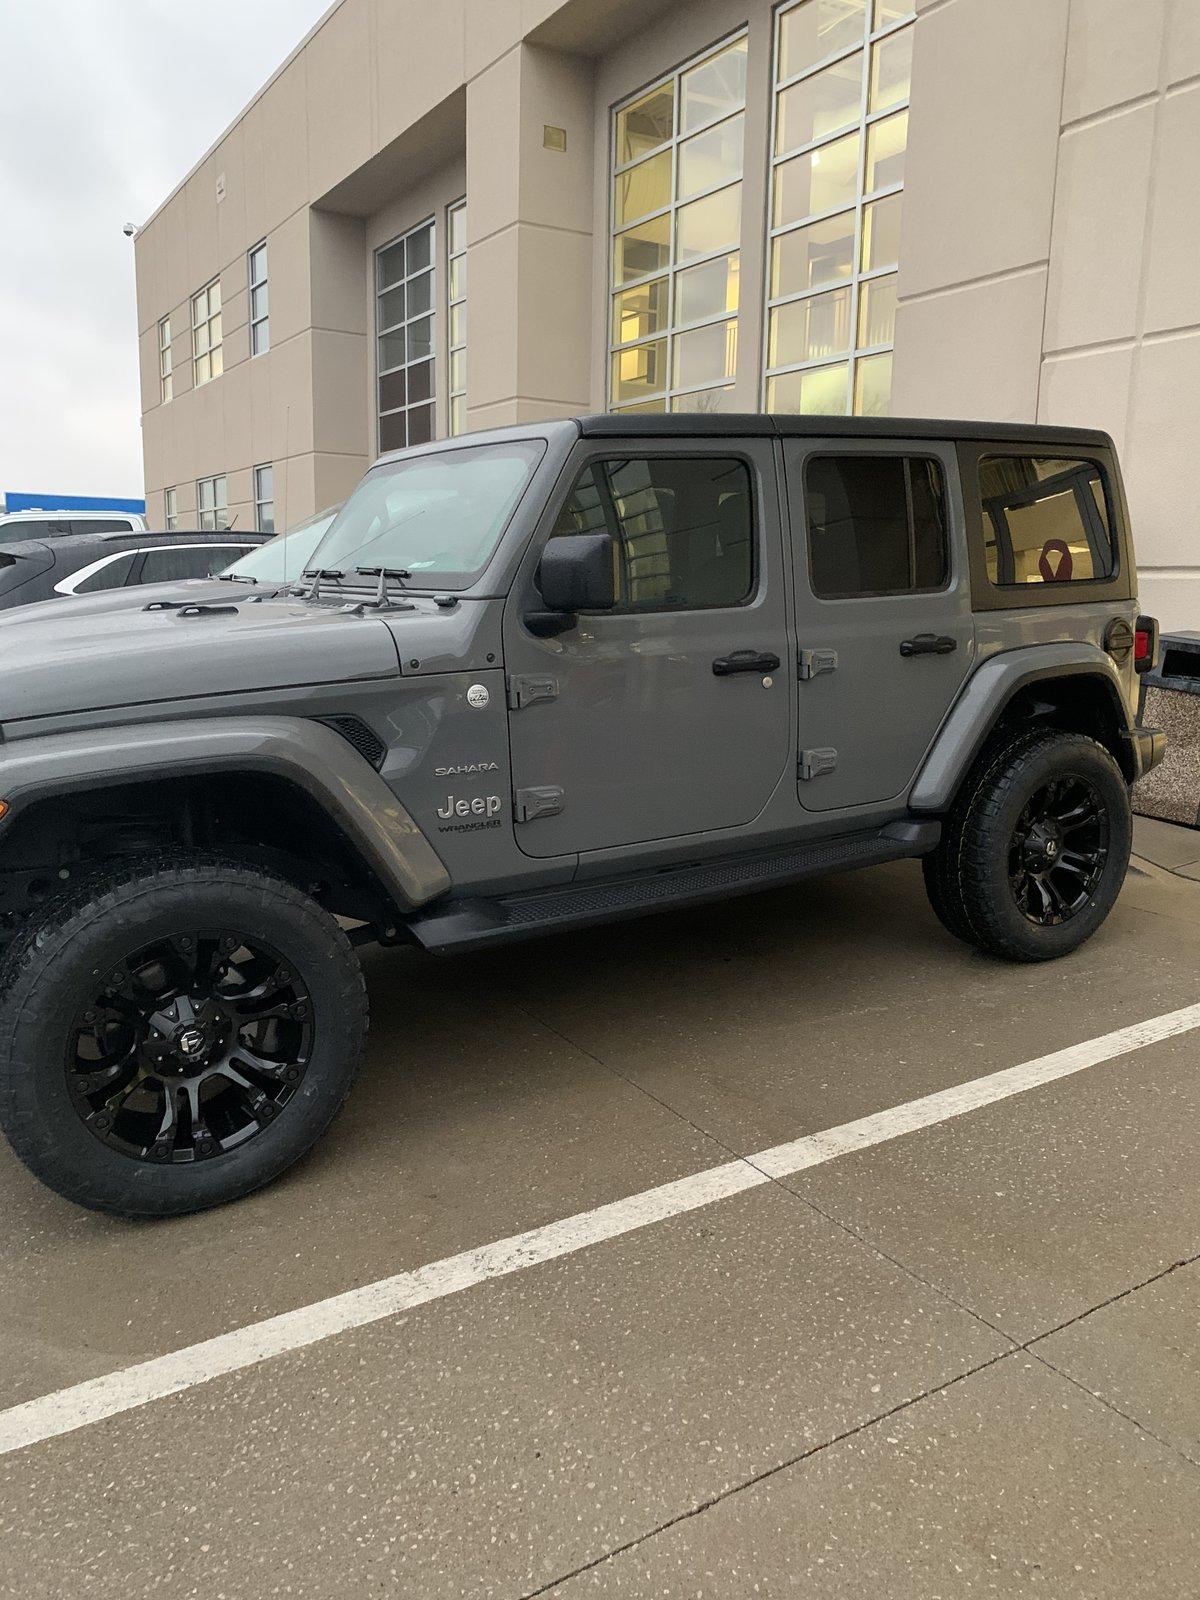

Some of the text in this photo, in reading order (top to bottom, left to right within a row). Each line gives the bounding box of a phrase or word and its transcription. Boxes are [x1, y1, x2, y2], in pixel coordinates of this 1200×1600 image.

[435, 762, 499, 776] SAHARA
[437, 795, 502, 819] Jeep
[438, 819, 501, 833] WRANGLER
